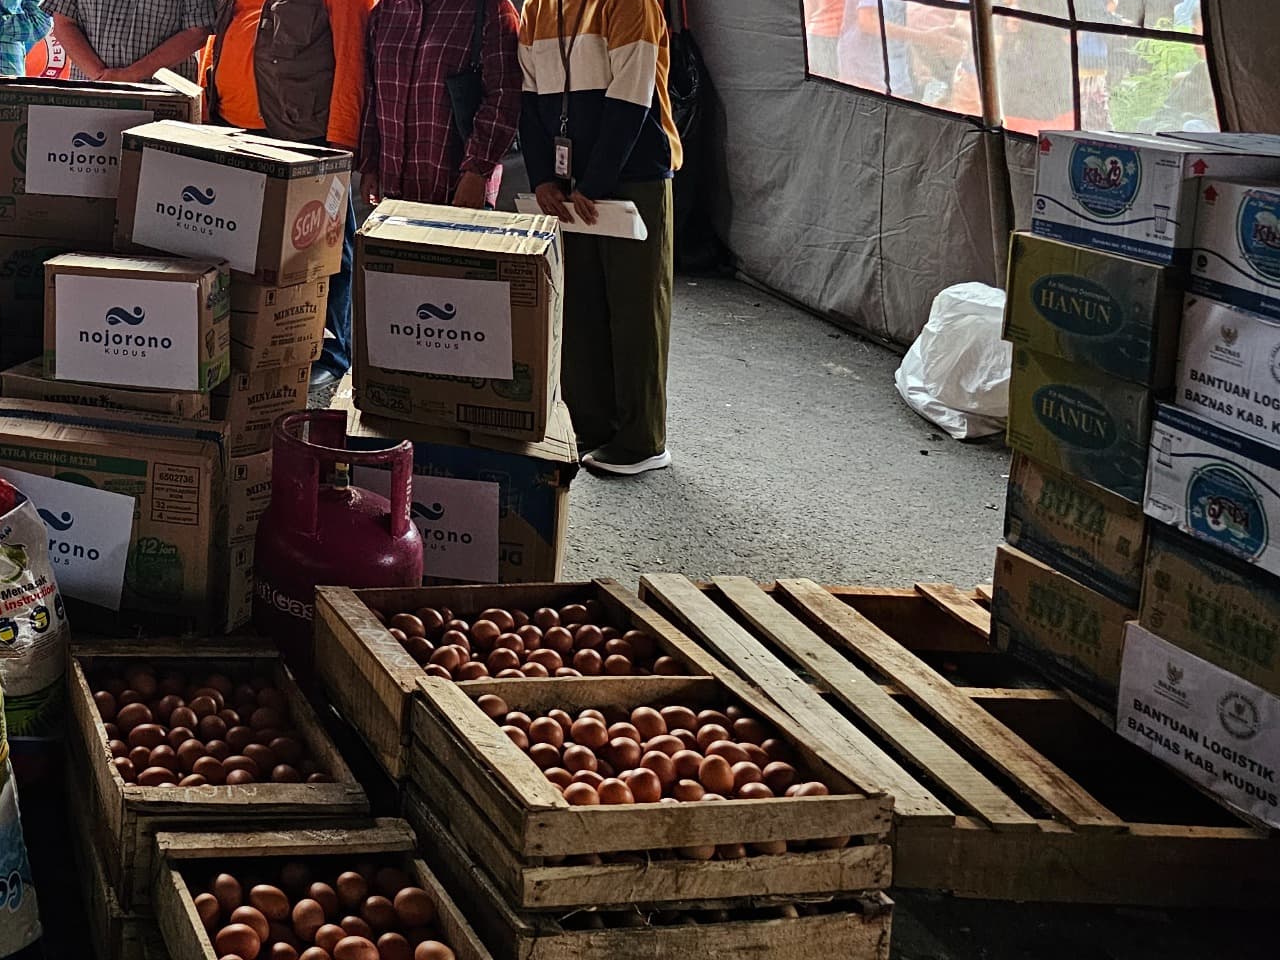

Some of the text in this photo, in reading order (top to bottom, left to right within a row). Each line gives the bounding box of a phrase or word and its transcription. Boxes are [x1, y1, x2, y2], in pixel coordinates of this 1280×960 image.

[47, 149, 117, 165] nojoron
[156, 202, 238, 231] nojorono
[294, 209, 321, 240] SGM
[176, 222, 214, 236] KUDUS
[1040, 288, 1112, 328] HANUN
[79, 329, 172, 349] nojorono
[390, 323, 486, 342] nojorono
[104, 348, 147, 358] KUDUS
[416, 341, 460, 350] KUDUS
[1190, 369, 1250, 400] BANTUAN
[1185, 388, 1233, 416] BAZNAS
[1237, 407, 1268, 429] KAB.
[1040, 398, 1110, 440] HANUN
[0, 446, 26, 459] XTRA
[29, 449, 67, 464] KERING
[138, 537, 158, 554] 12
[420, 528, 472, 544] rono
[48, 539, 100, 560] rono
[1133, 698, 1276, 783] BANTUAN LOGISTIK
[1128, 717, 1279, 808] BAZNAS KAB. KUDUS
